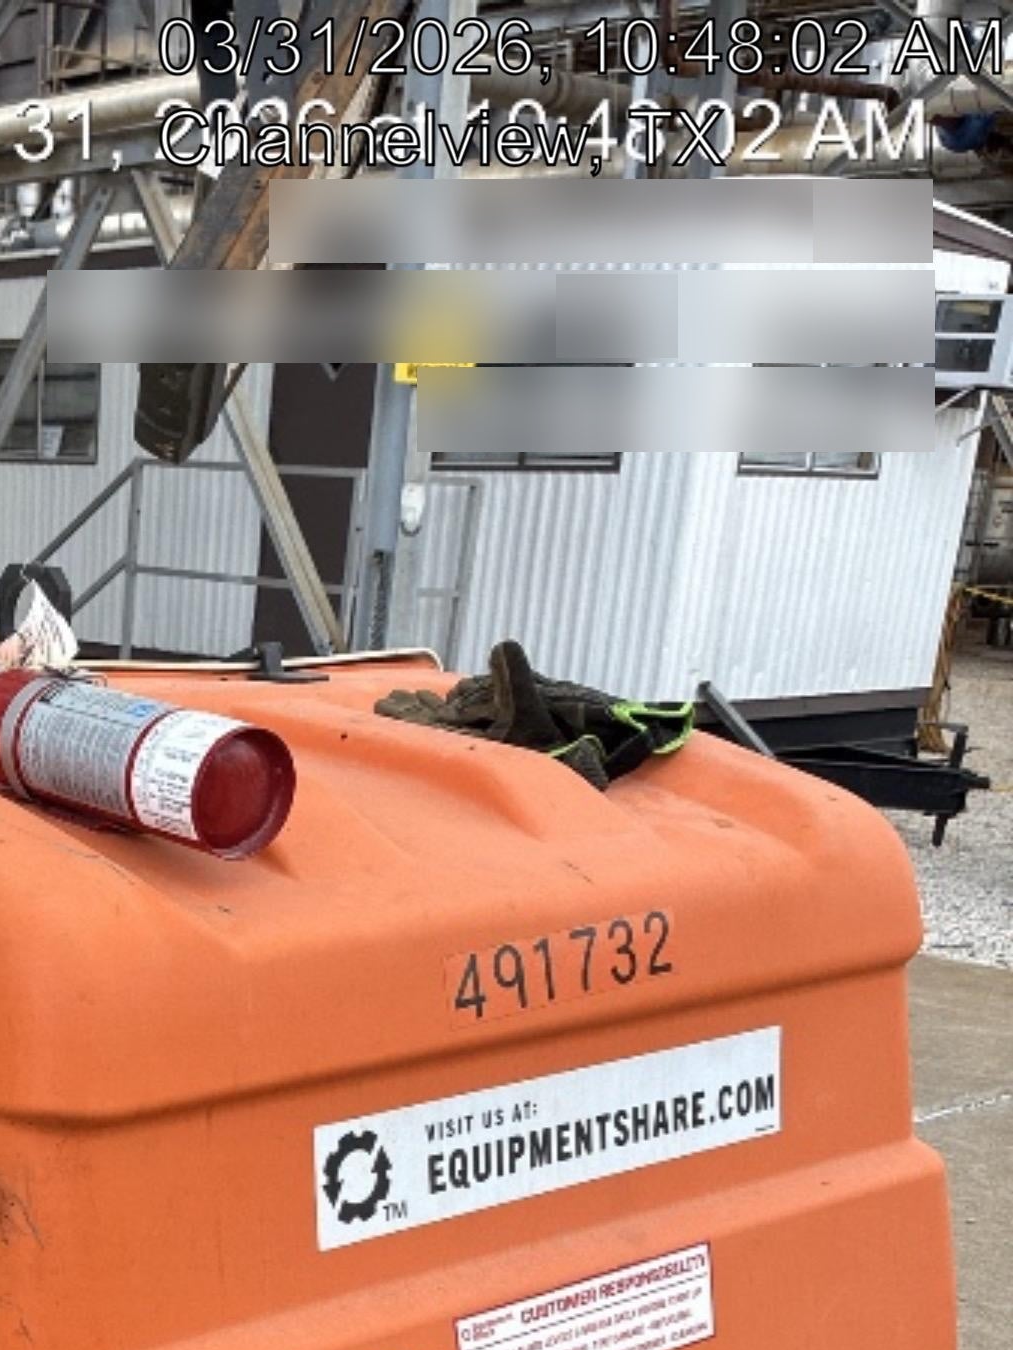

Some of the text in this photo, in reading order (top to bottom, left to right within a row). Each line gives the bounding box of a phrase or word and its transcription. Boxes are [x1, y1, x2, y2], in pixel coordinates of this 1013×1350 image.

[453, 911, 673, 1018] 491732
[425, 1115, 474, 1142] VISIT
[483, 1108, 504, 1128] US
[427, 1074, 775, 1195] EQUIPMENTSHARE.COM
